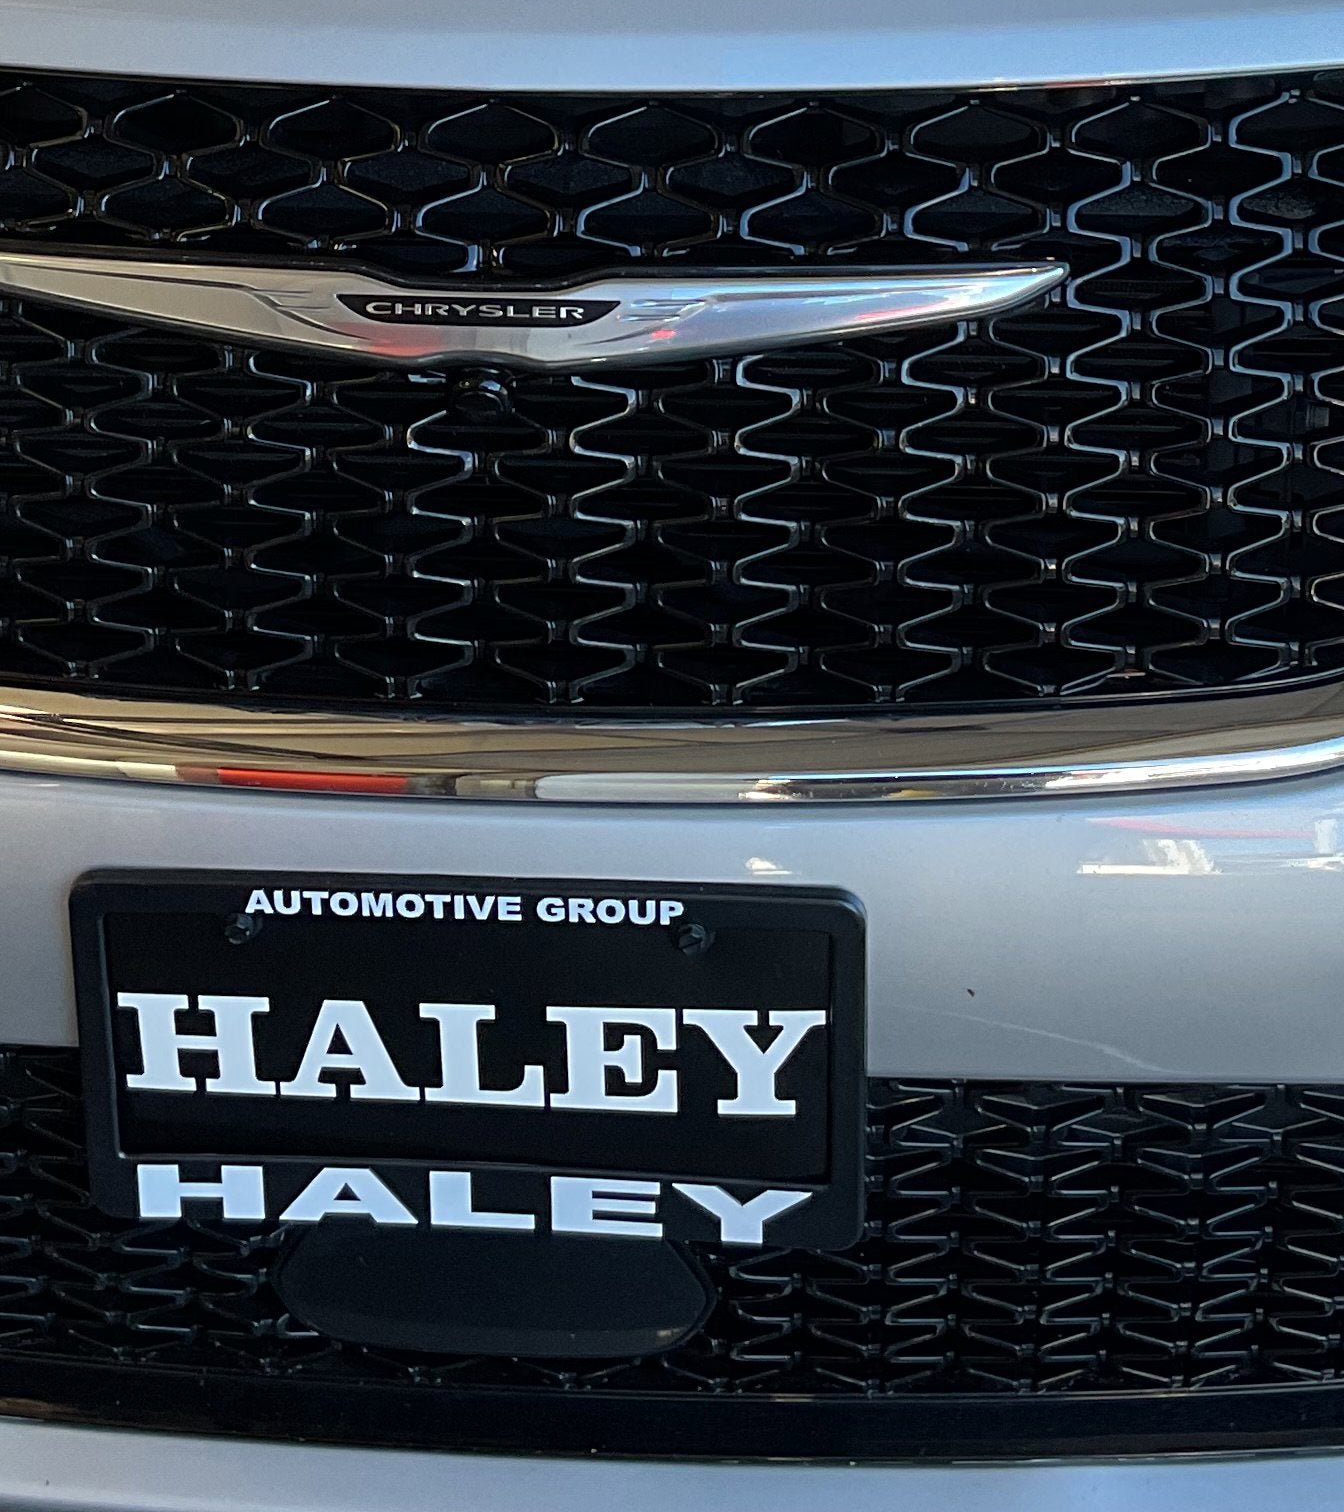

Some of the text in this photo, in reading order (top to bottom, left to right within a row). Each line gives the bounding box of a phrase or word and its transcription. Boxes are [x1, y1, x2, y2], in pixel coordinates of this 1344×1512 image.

[365, 301, 585, 319] CHRYSLER
[245, 889, 685, 926] AUTOMOTIVE GROUP
[117, 992, 826, 1116] HALEY
[137, 1164, 813, 1244] HALEY
